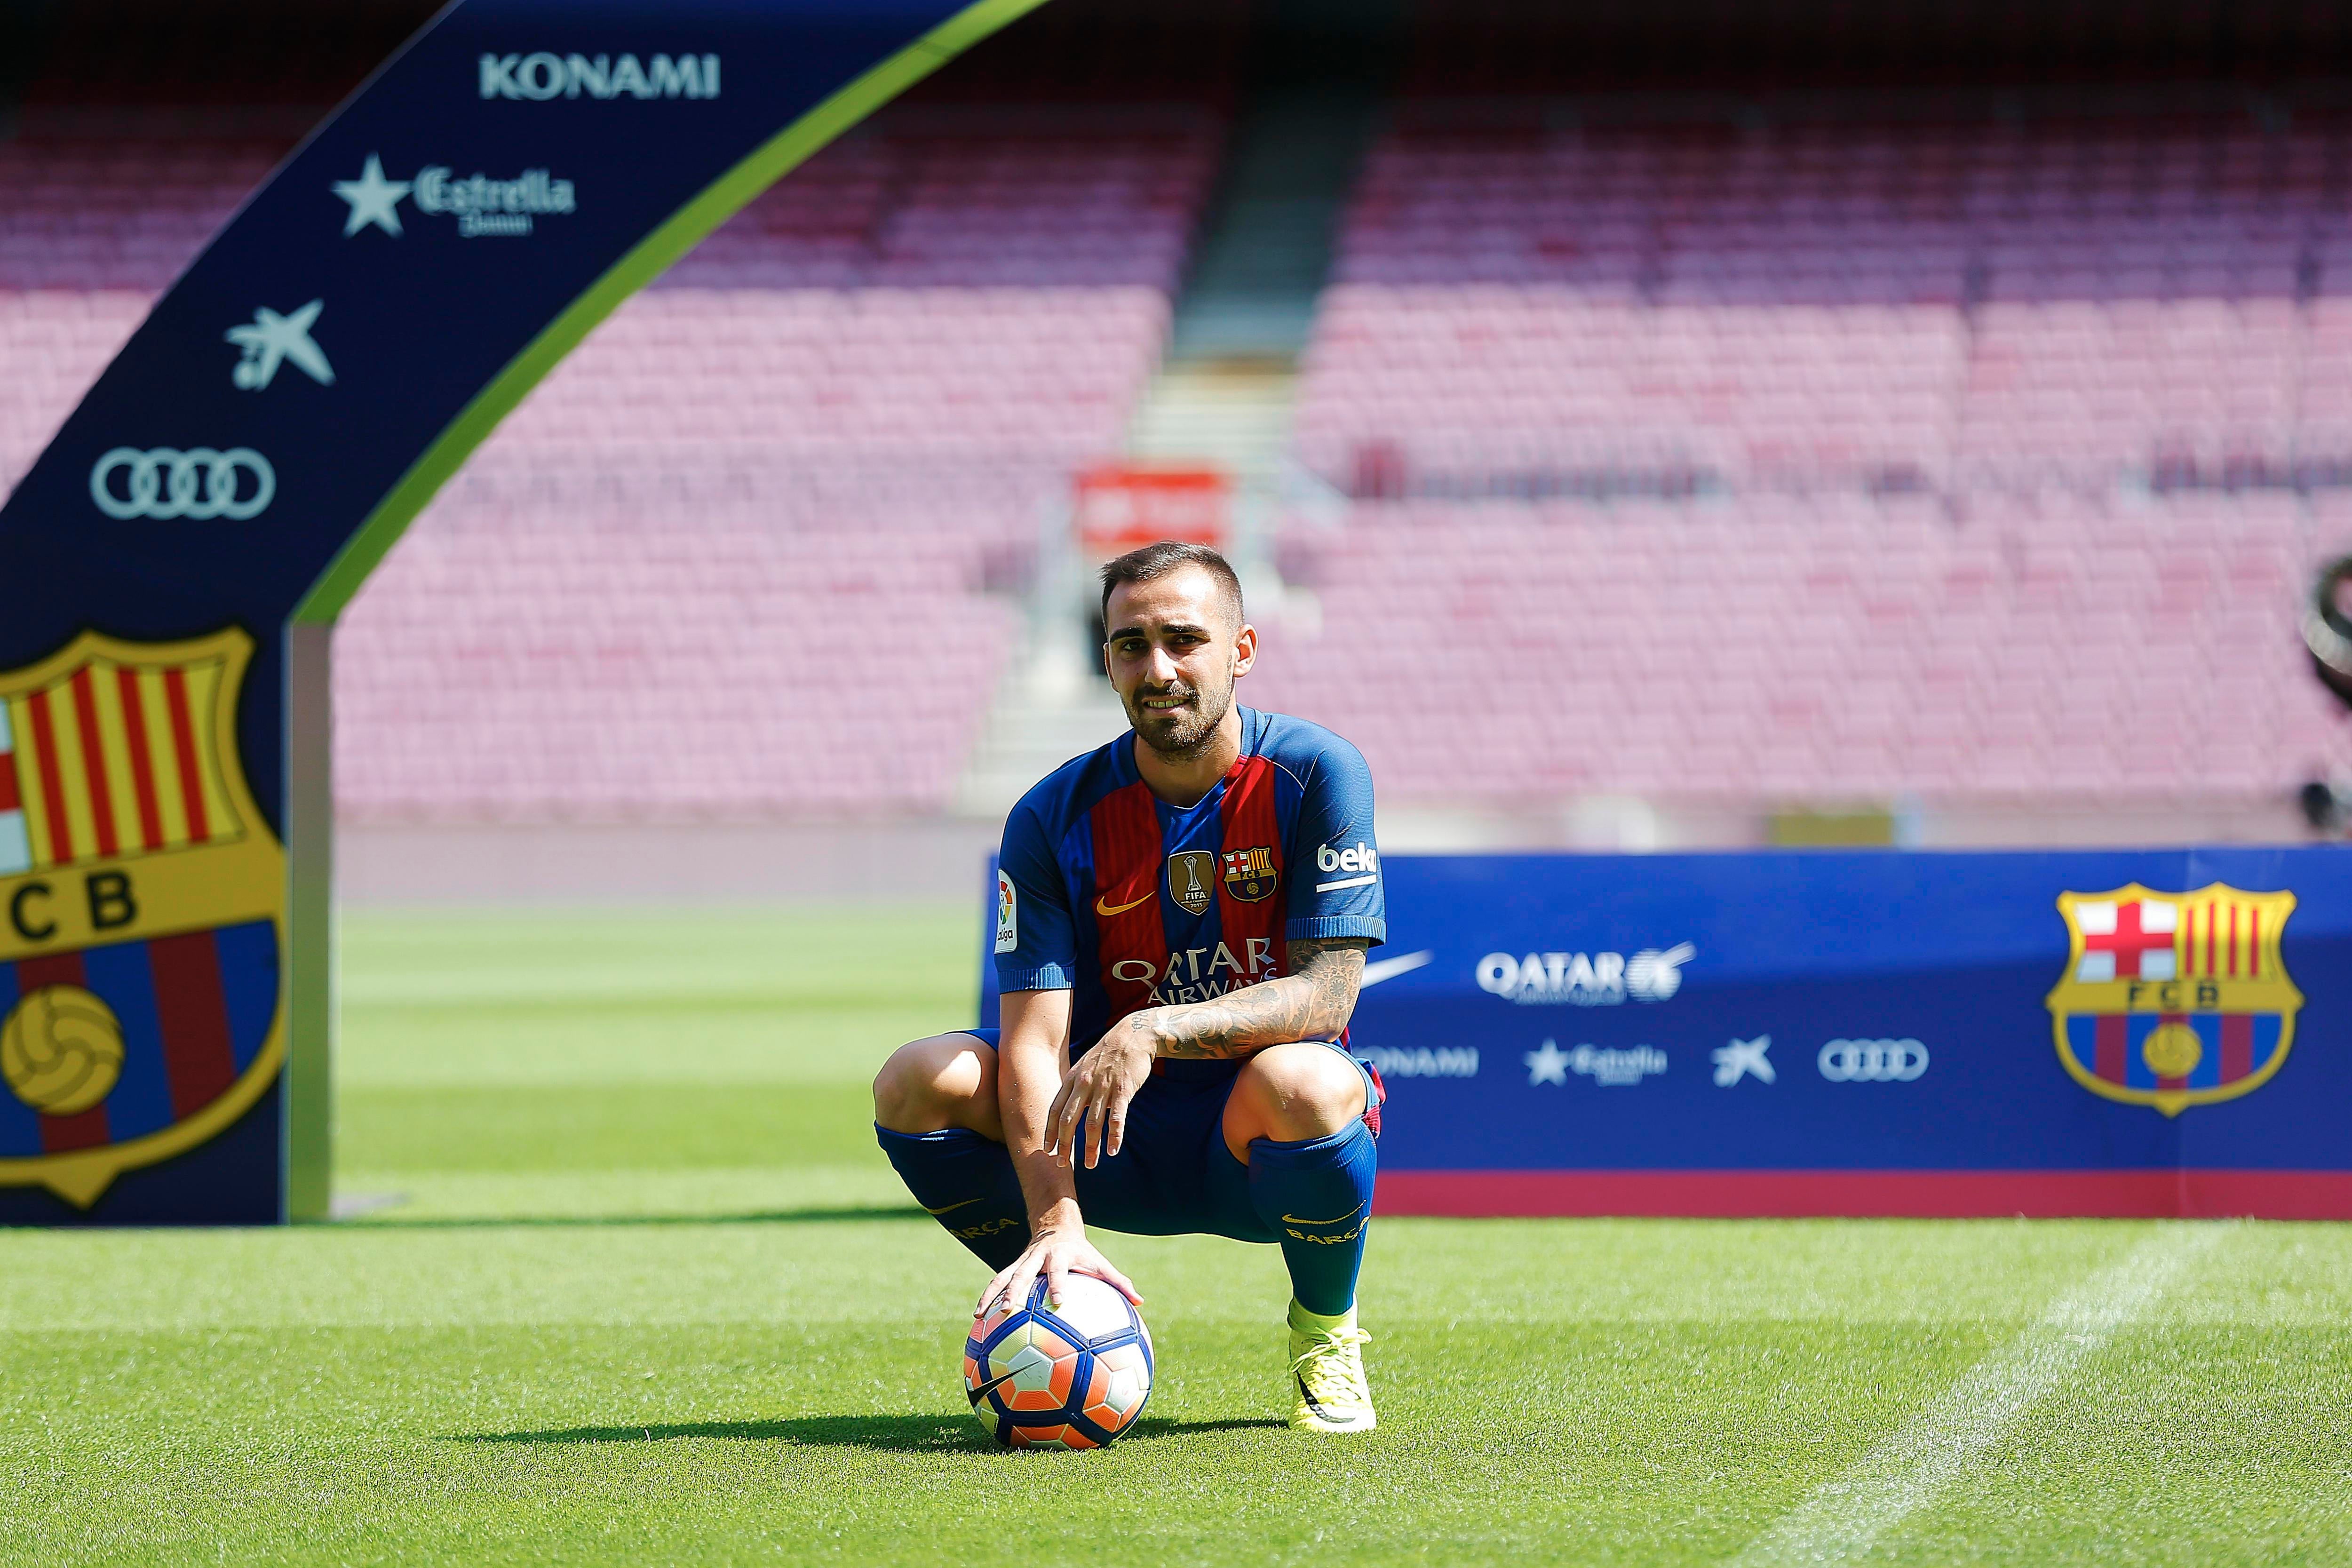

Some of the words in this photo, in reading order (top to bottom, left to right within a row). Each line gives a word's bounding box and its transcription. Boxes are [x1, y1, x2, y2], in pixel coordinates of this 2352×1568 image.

[479, 53, 721, 100] KONAMI
[413, 165, 576, 215] Estrella
[1318, 842, 1376, 873] beko
[1240, 871, 1261, 879] FCB
[1185, 891, 1207, 900] FIFA
[997, 927, 1013, 942] aLiga
[1112, 938, 1276, 990] QATAR
[1476, 952, 1626, 998] QATAR
[949, 1218, 1019, 1239] ARÇA
[1286, 1216, 1371, 1244] BARÇA
